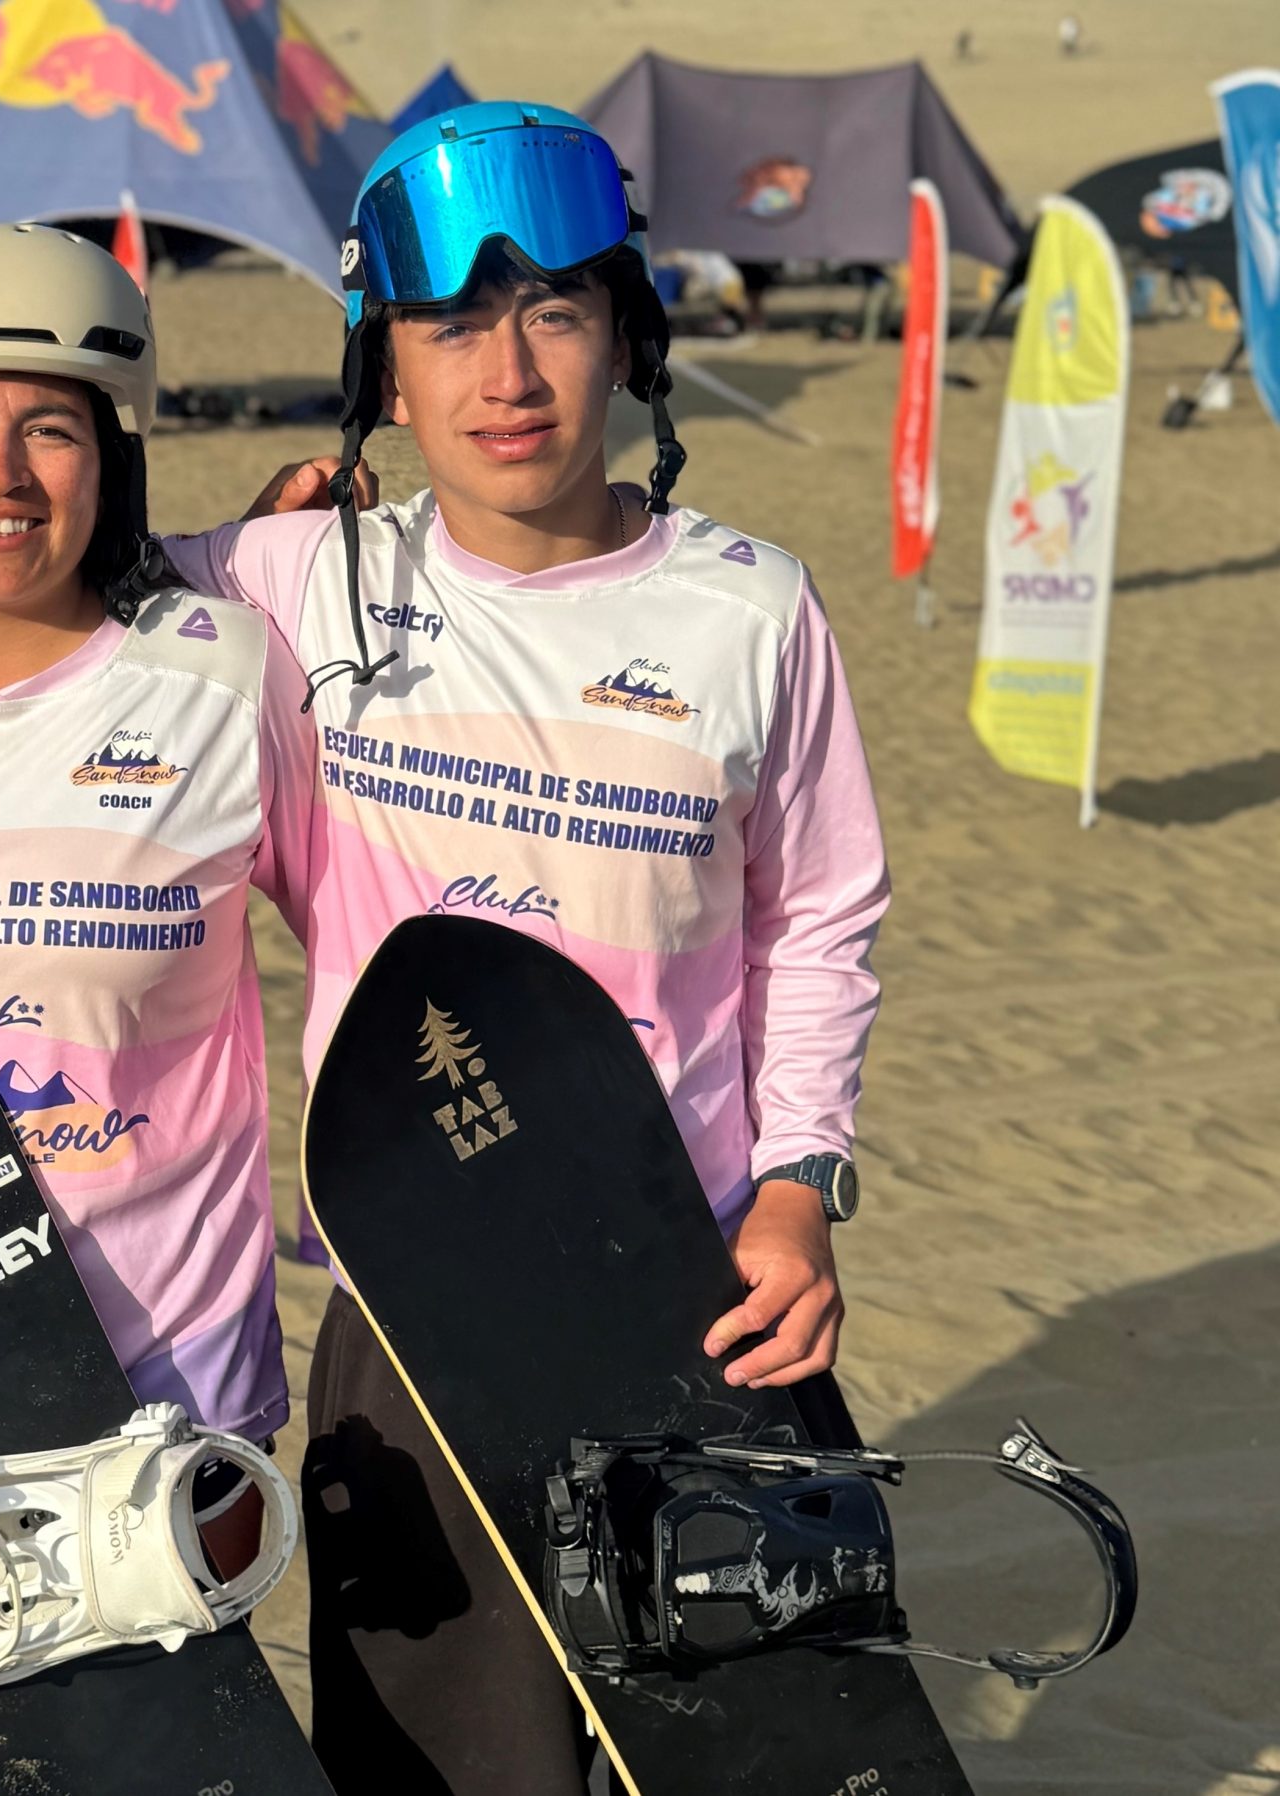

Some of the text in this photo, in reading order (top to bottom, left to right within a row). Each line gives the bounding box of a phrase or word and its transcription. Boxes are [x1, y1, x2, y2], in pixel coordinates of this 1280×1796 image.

[367, 602, 444, 642] celtry
[99, 794, 152, 809] COACH
[399, 744, 534, 797] MUNICIPAL
[539, 772, 571, 803] DE
[575, 779, 719, 823] SANDBOARD
[323, 760, 715, 858] EN ESARROLLO AL ALTO RENDIMIENTO
[8, 881, 43, 907] DE
[49, 881, 202, 912] SANDBOARD
[442, 873, 556, 921] Club
[43, 919, 206, 951] RENDIMIENTO
[845, 1767, 879, 1796] Pro
